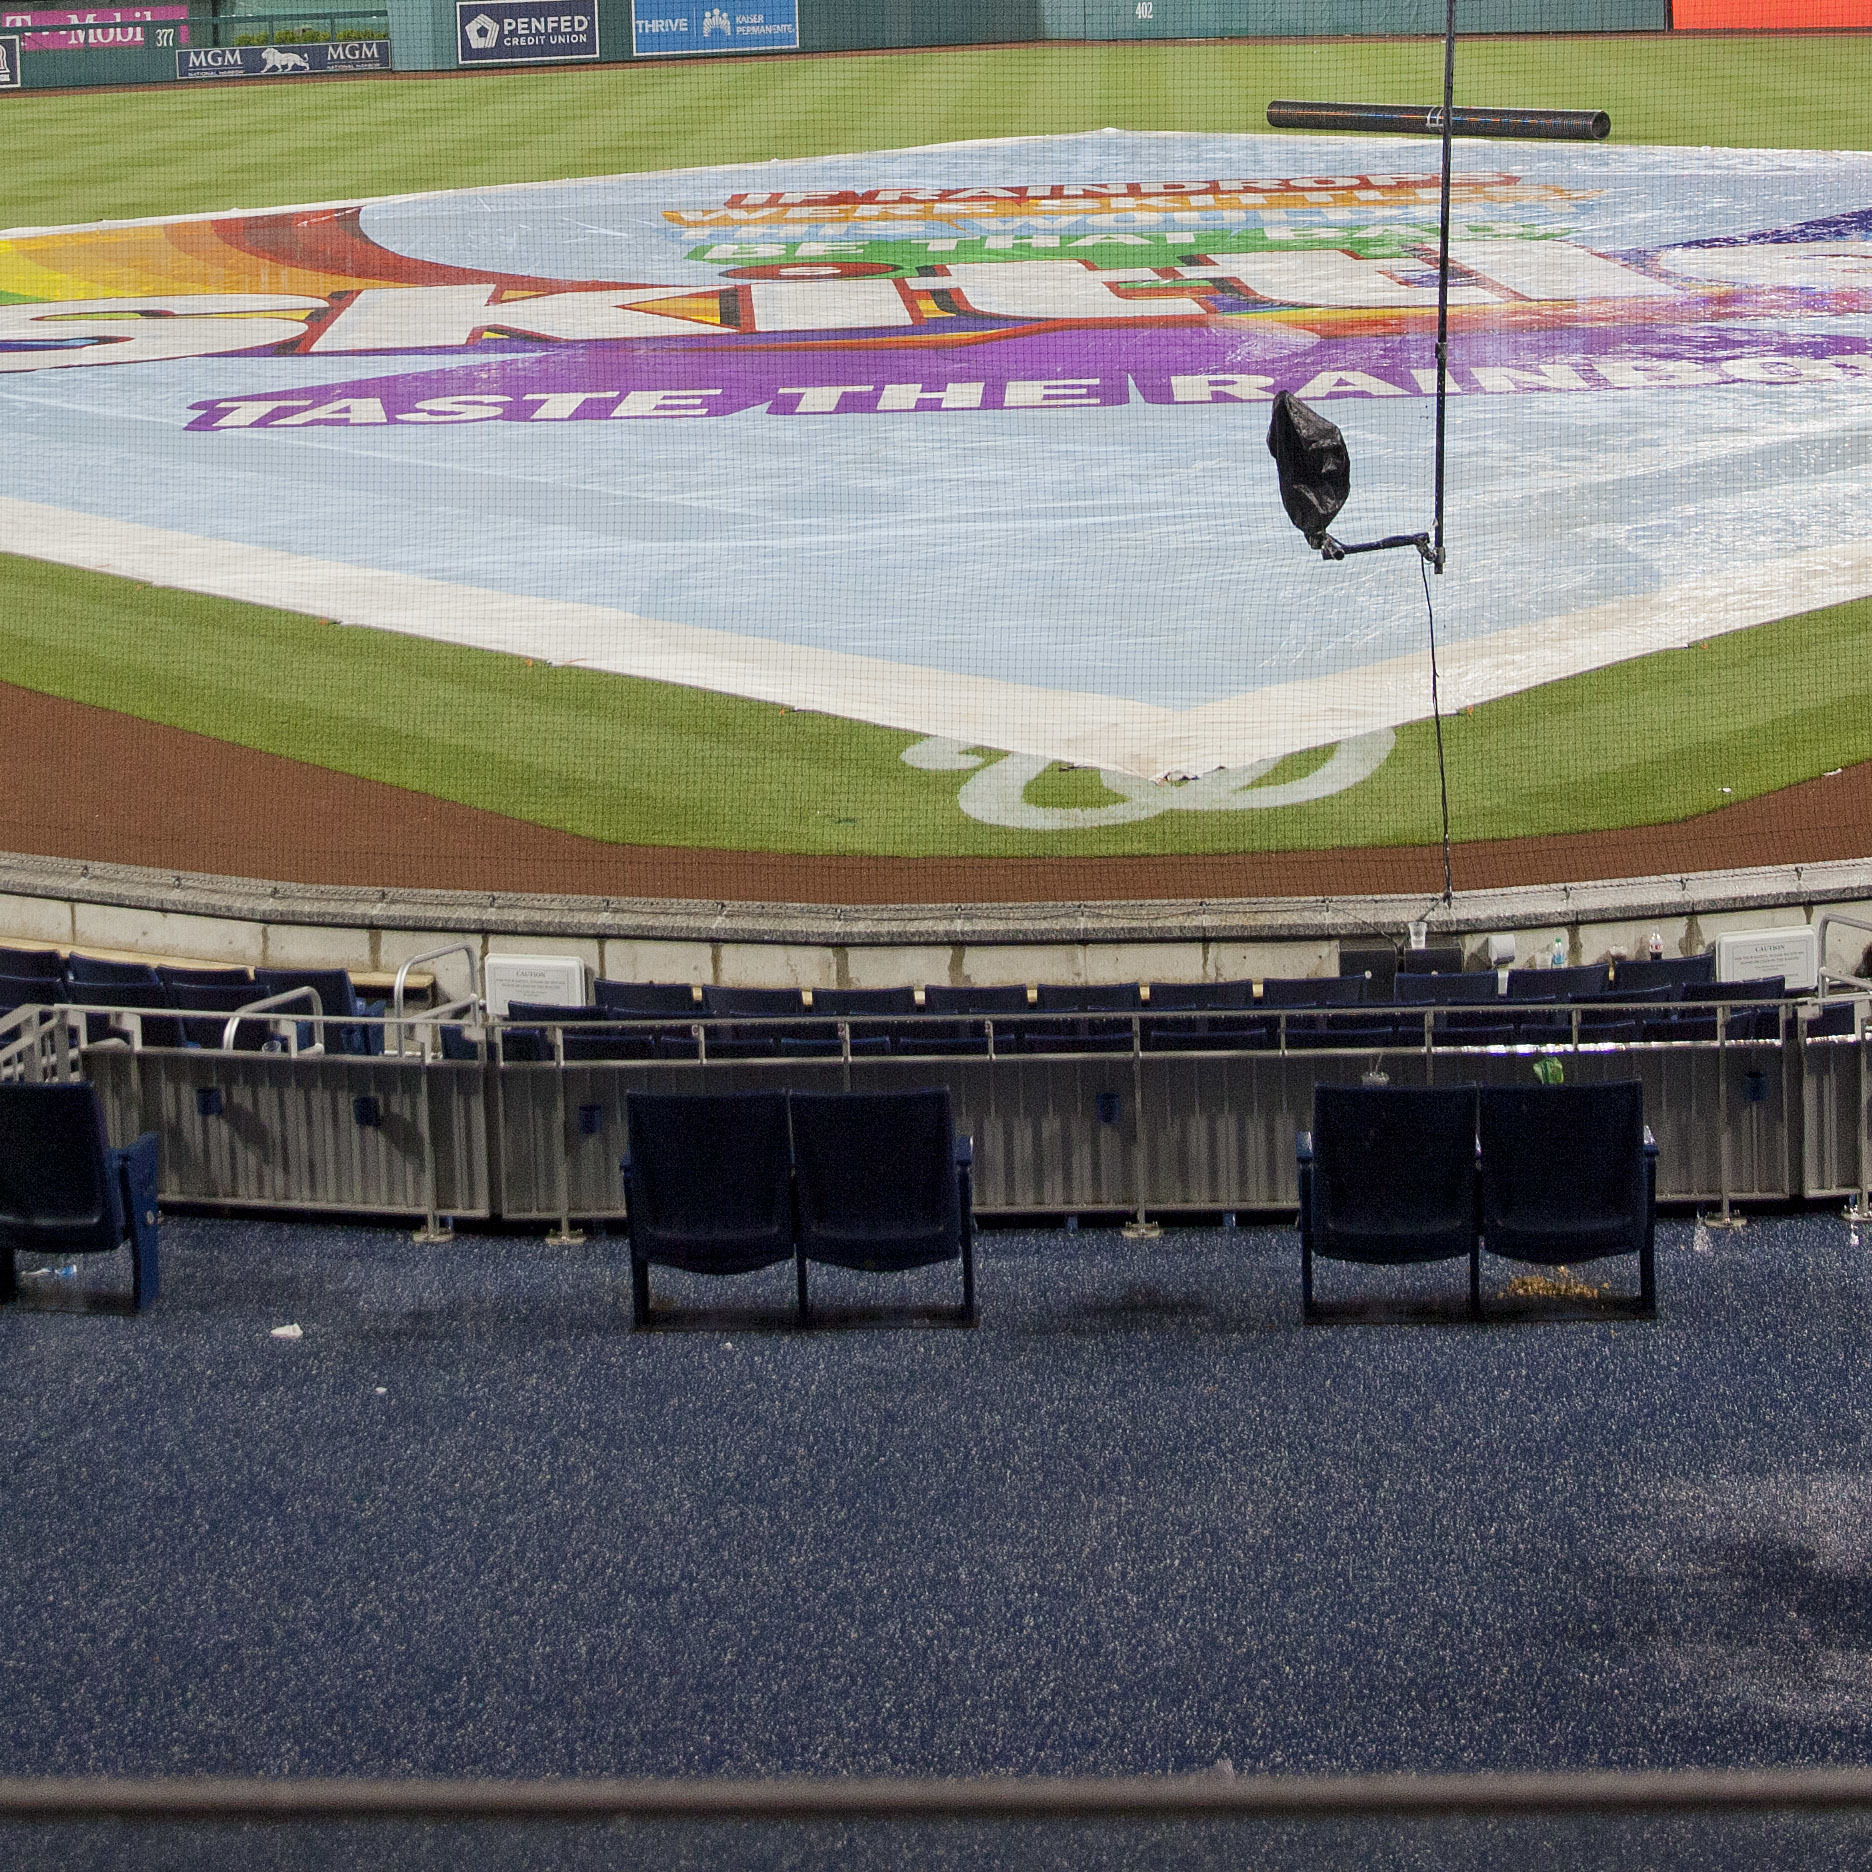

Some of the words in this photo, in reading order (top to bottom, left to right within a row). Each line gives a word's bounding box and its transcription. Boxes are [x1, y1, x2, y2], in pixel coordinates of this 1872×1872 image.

[504, 15, 589, 36] PENFED
[636, 18, 689, 34] THRIVE
[736, 14, 764, 25] KAISER
[155, 28, 175, 48] 377
[503, 35, 546, 47] CREDIT
[549, 33, 588, 45] UNION
[189, 49, 243, 68] MGM
[327, 42, 379, 61] MGM
[739, 191, 844, 206] IF
[874, 171, 1519, 201] RAINDROPS
[679, 201, 996, 222] WERE
[1033, 184, 1570, 211] SKITTLES
[679, 220, 931, 240] THIS
[701, 241, 867, 260] BE
[910, 231, 1207, 252] THAT
[209, 391, 726, 426] TASTE
[778, 381, 1120, 414] THE
